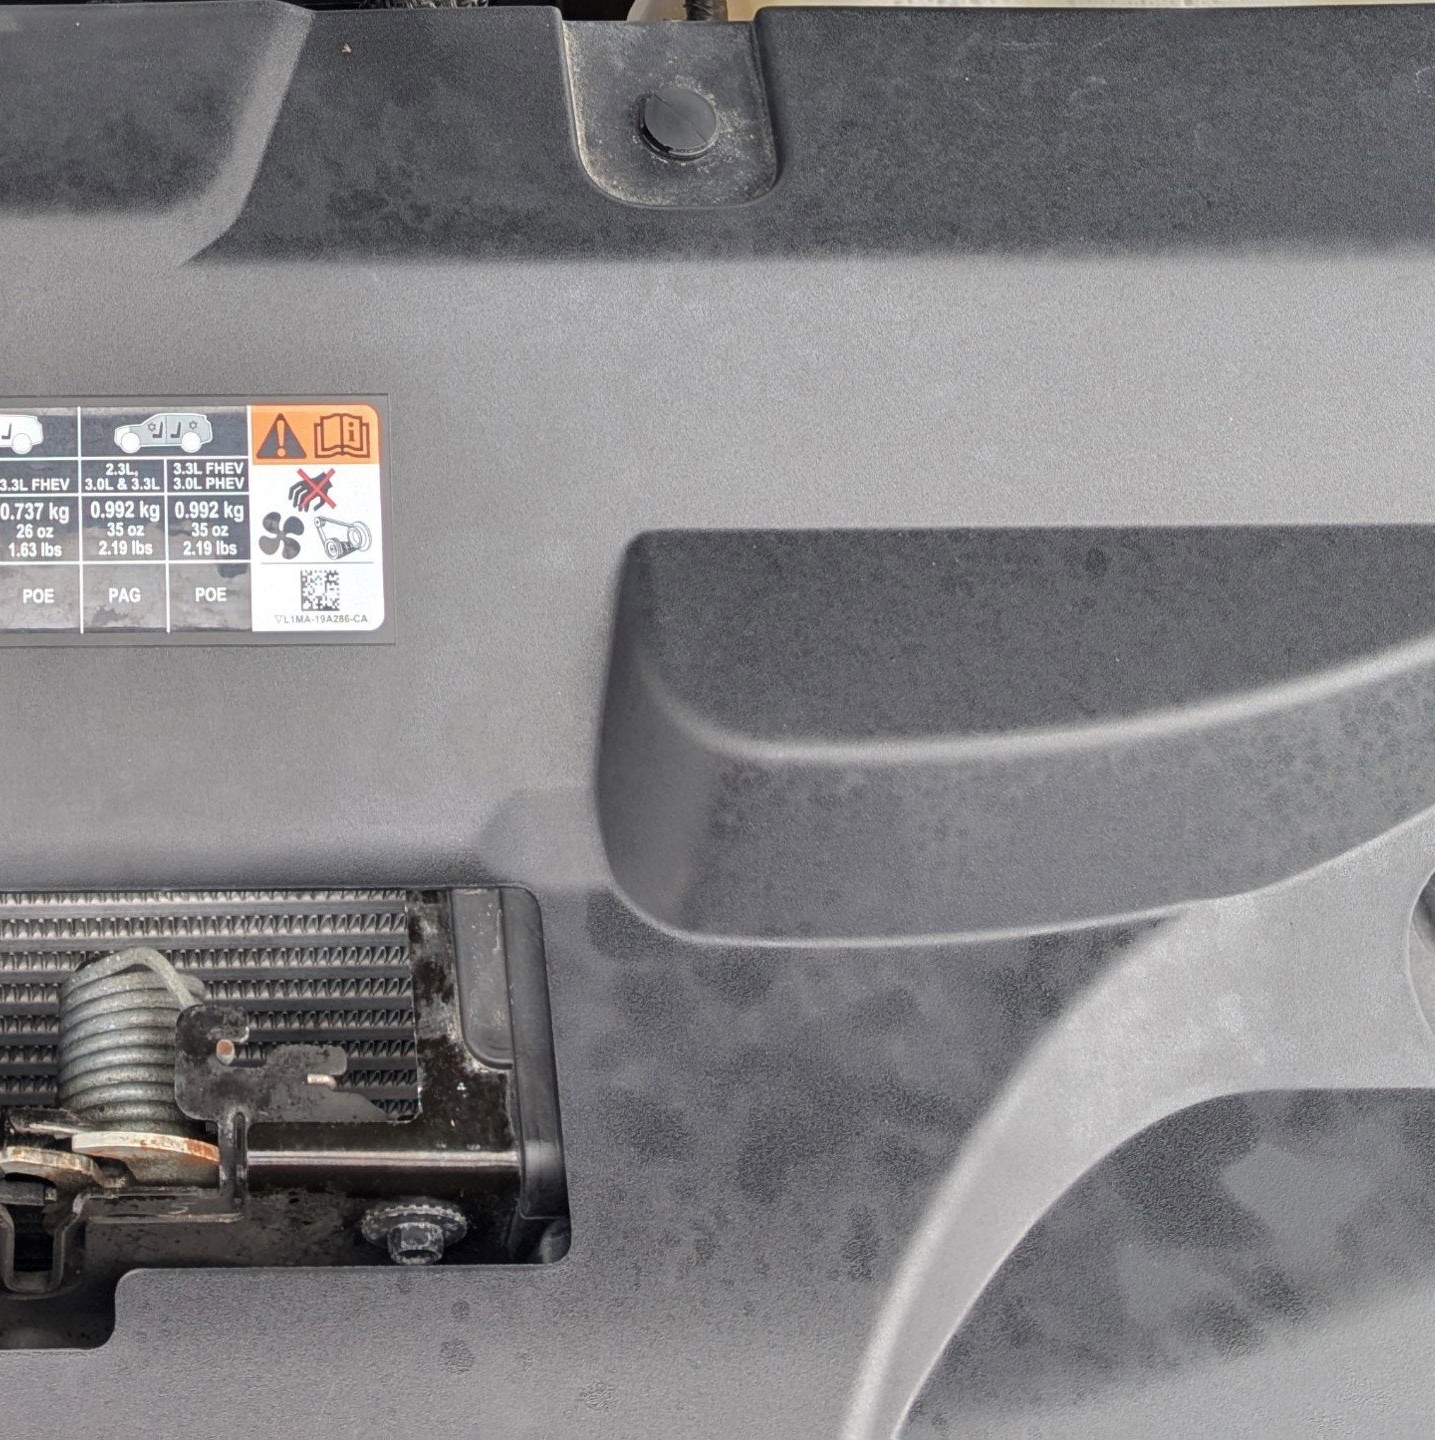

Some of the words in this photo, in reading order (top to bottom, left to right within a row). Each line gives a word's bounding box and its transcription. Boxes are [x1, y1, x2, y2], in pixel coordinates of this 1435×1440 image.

[106, 463, 138, 476] 2.3L,
[173, 462, 202, 474] 3.3L
[206, 462, 244, 474] FHEV
[0, 479, 28, 491] 3.3L
[32, 478, 70, 491] FHEV
[85, 478, 114, 490] 3.0L
[117, 479, 127, 490] &
[132, 478, 160, 490] 3.3L
[173, 477, 202, 489] 3.0L
[206, 477, 244, 489] PHEV
[0, 503, 43, 520] 0.737
[49, 502, 69, 524] kg
[90, 501, 134, 518] 0.992
[140, 500, 160, 522] kg
[175, 501, 219, 518] 0.992
[224, 501, 244, 522] kg
[16, 524, 33, 538] 26
[37, 527, 54, 538] oz
[107, 523, 123, 536] 35
[128, 525, 145, 536] oz
[191, 523, 208, 537] 35
[212, 525, 229, 536] oz
[8, 542, 36, 557] 1.63
[41, 542, 62, 557] lbs
[98, 541, 127, 555] 2.19
[132, 541, 153, 555] lbs
[183, 541, 212, 555] 2.19
[216, 541, 237, 555] lbs
[23, 589, 54, 603] POE
[109, 588, 141, 603] PAG
[195, 587, 227, 602] POE
[284, 614, 368, 623] L1MA-19A286-CA
